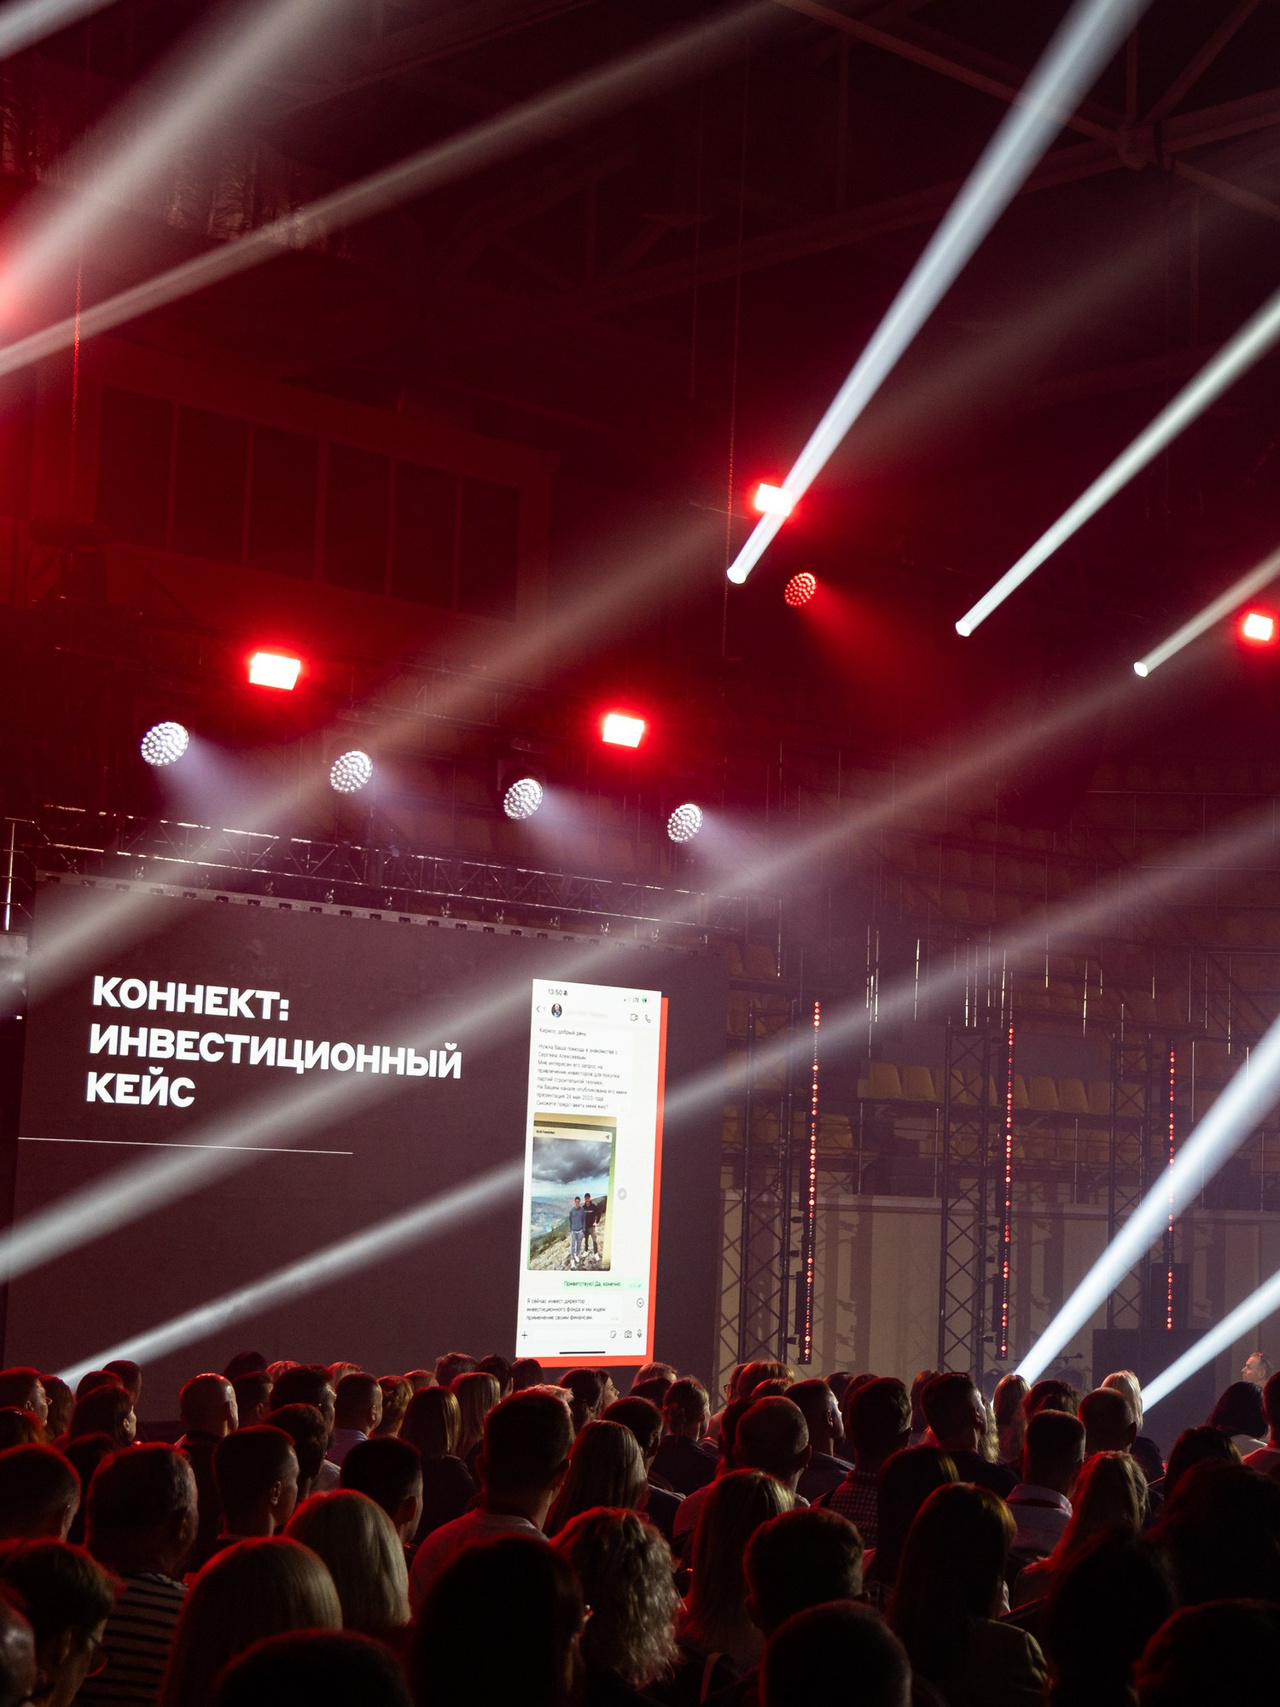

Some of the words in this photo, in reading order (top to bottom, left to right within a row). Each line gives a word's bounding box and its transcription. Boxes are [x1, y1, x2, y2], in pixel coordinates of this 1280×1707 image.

[92, 975, 290, 1021] КОННЕКТ:
[547, 988, 563, 996] 13:50
[88, 1023, 463, 1079] ИНВЕСТИЦИОННЫЙ
[86, 1066, 196, 1108] КЕЙС
